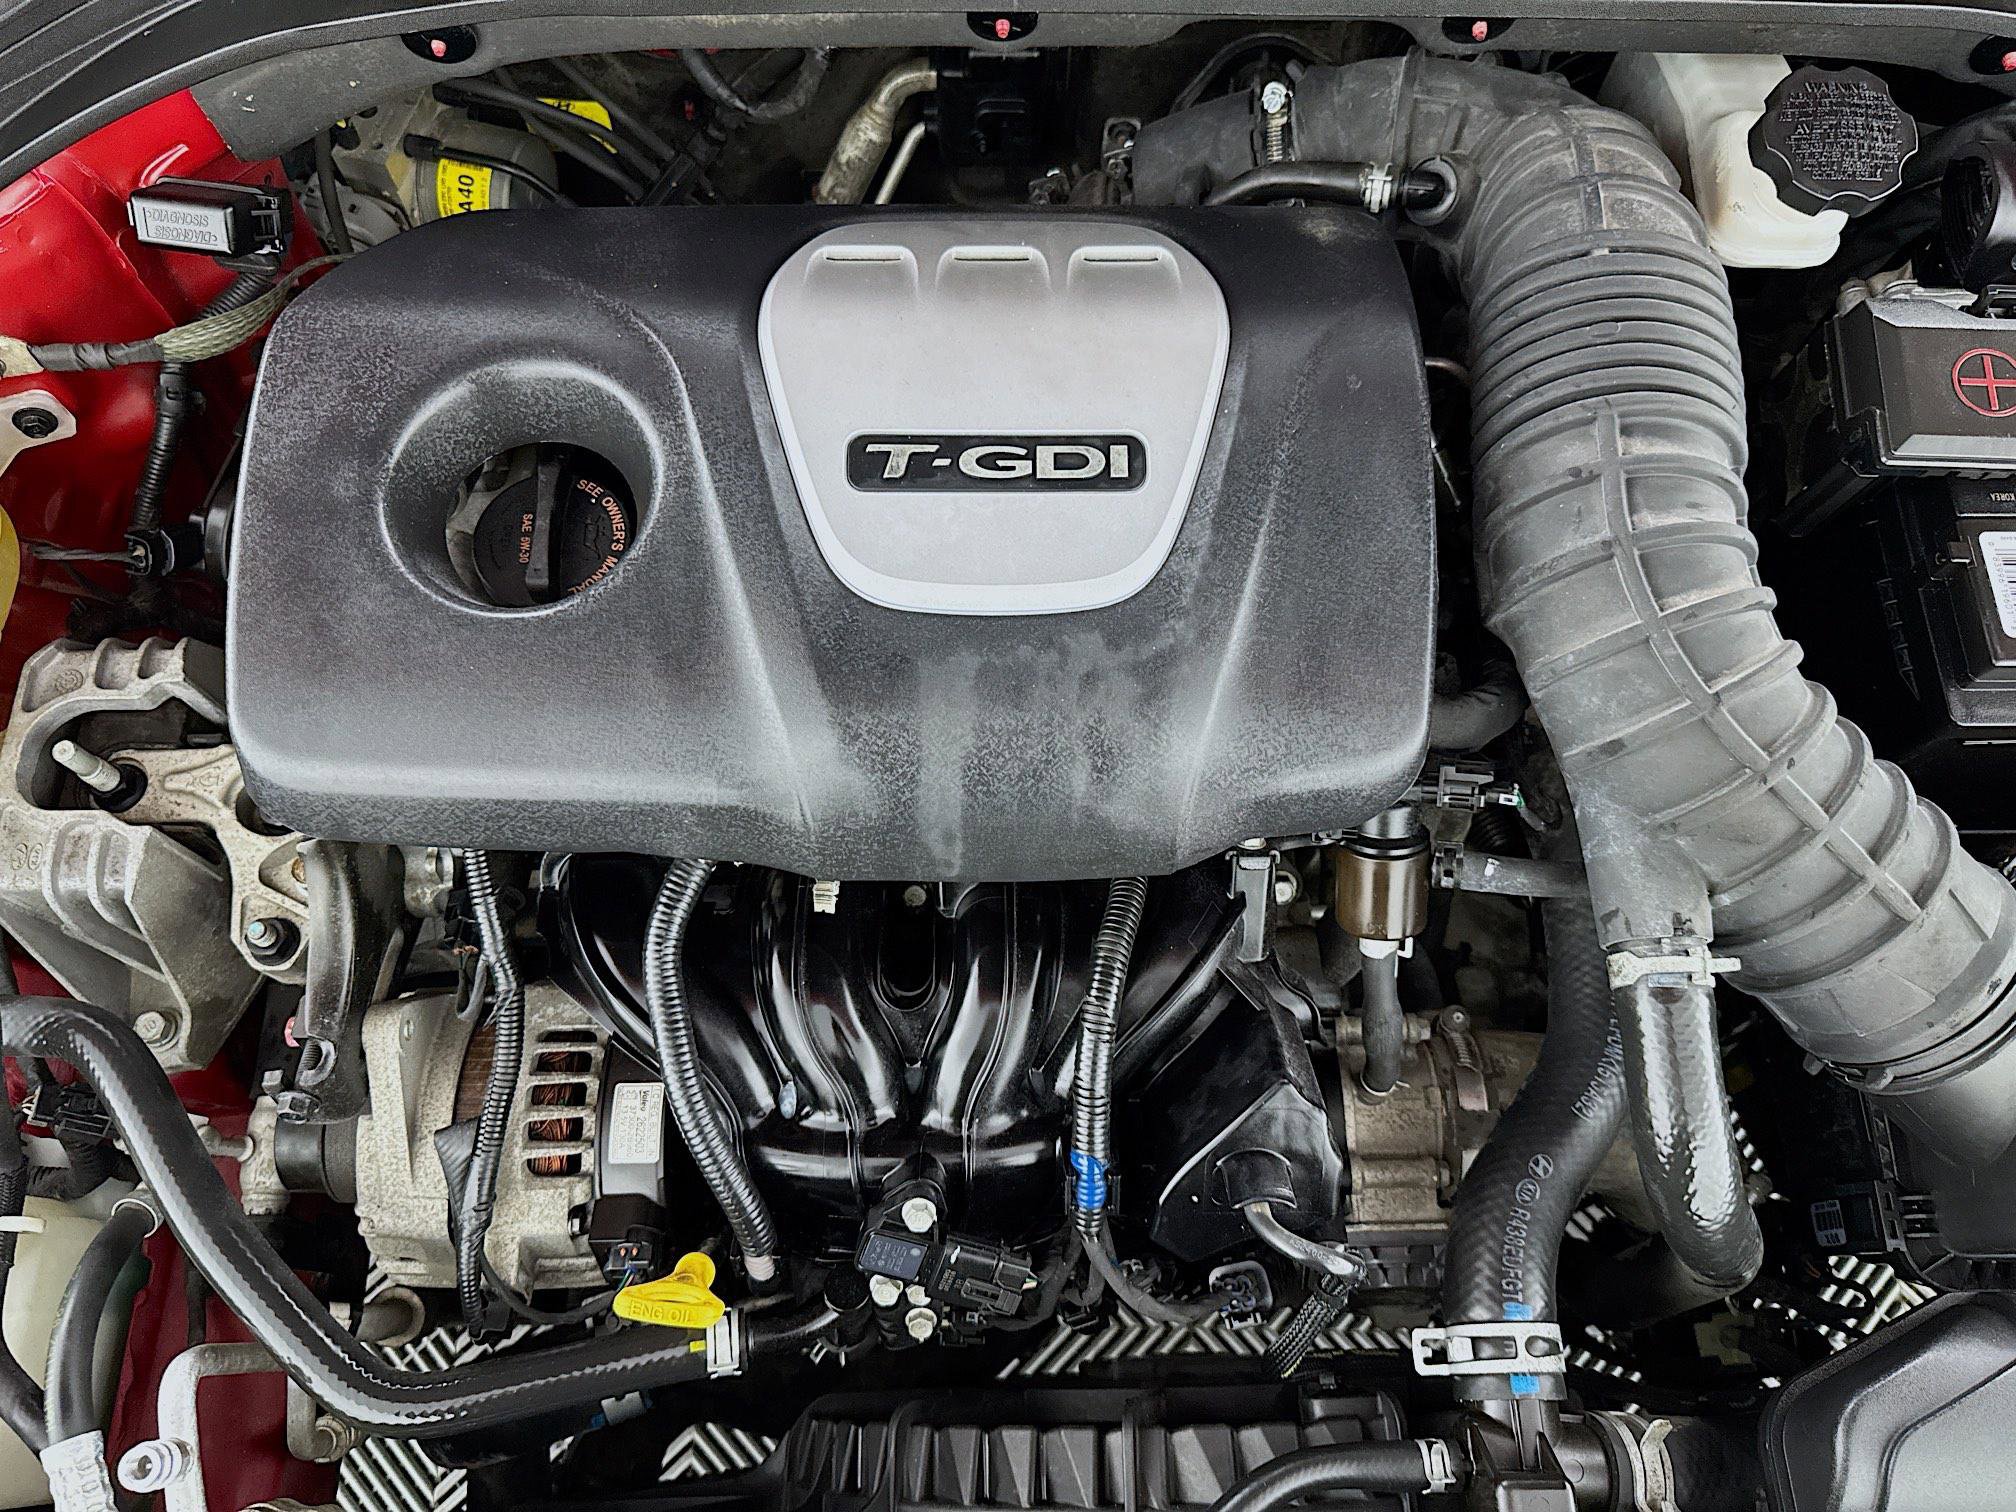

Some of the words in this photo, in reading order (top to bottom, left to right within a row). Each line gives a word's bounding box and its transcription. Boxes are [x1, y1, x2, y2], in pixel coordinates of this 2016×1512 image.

[458, 173, 475, 213] A40
[151, 208, 209, 228] DIAGNOSIS
[154, 224, 212, 244] DIAGNOSIS
[866, 443, 1129, 480] T-GDI
[577, 479, 604, 498] SEE
[1989, 492, 2016, 501] KOREA
[521, 513, 534, 533] SAE
[601, 496, 626, 552] OWNER'S
[567, 555, 619, 593] MANUAL
[640, 1090, 651, 1112] Valeo
[1518, 1180, 1538, 1204] KIA
[630, 1300, 663, 1318] ENG
[668, 1308, 692, 1323] OIL
